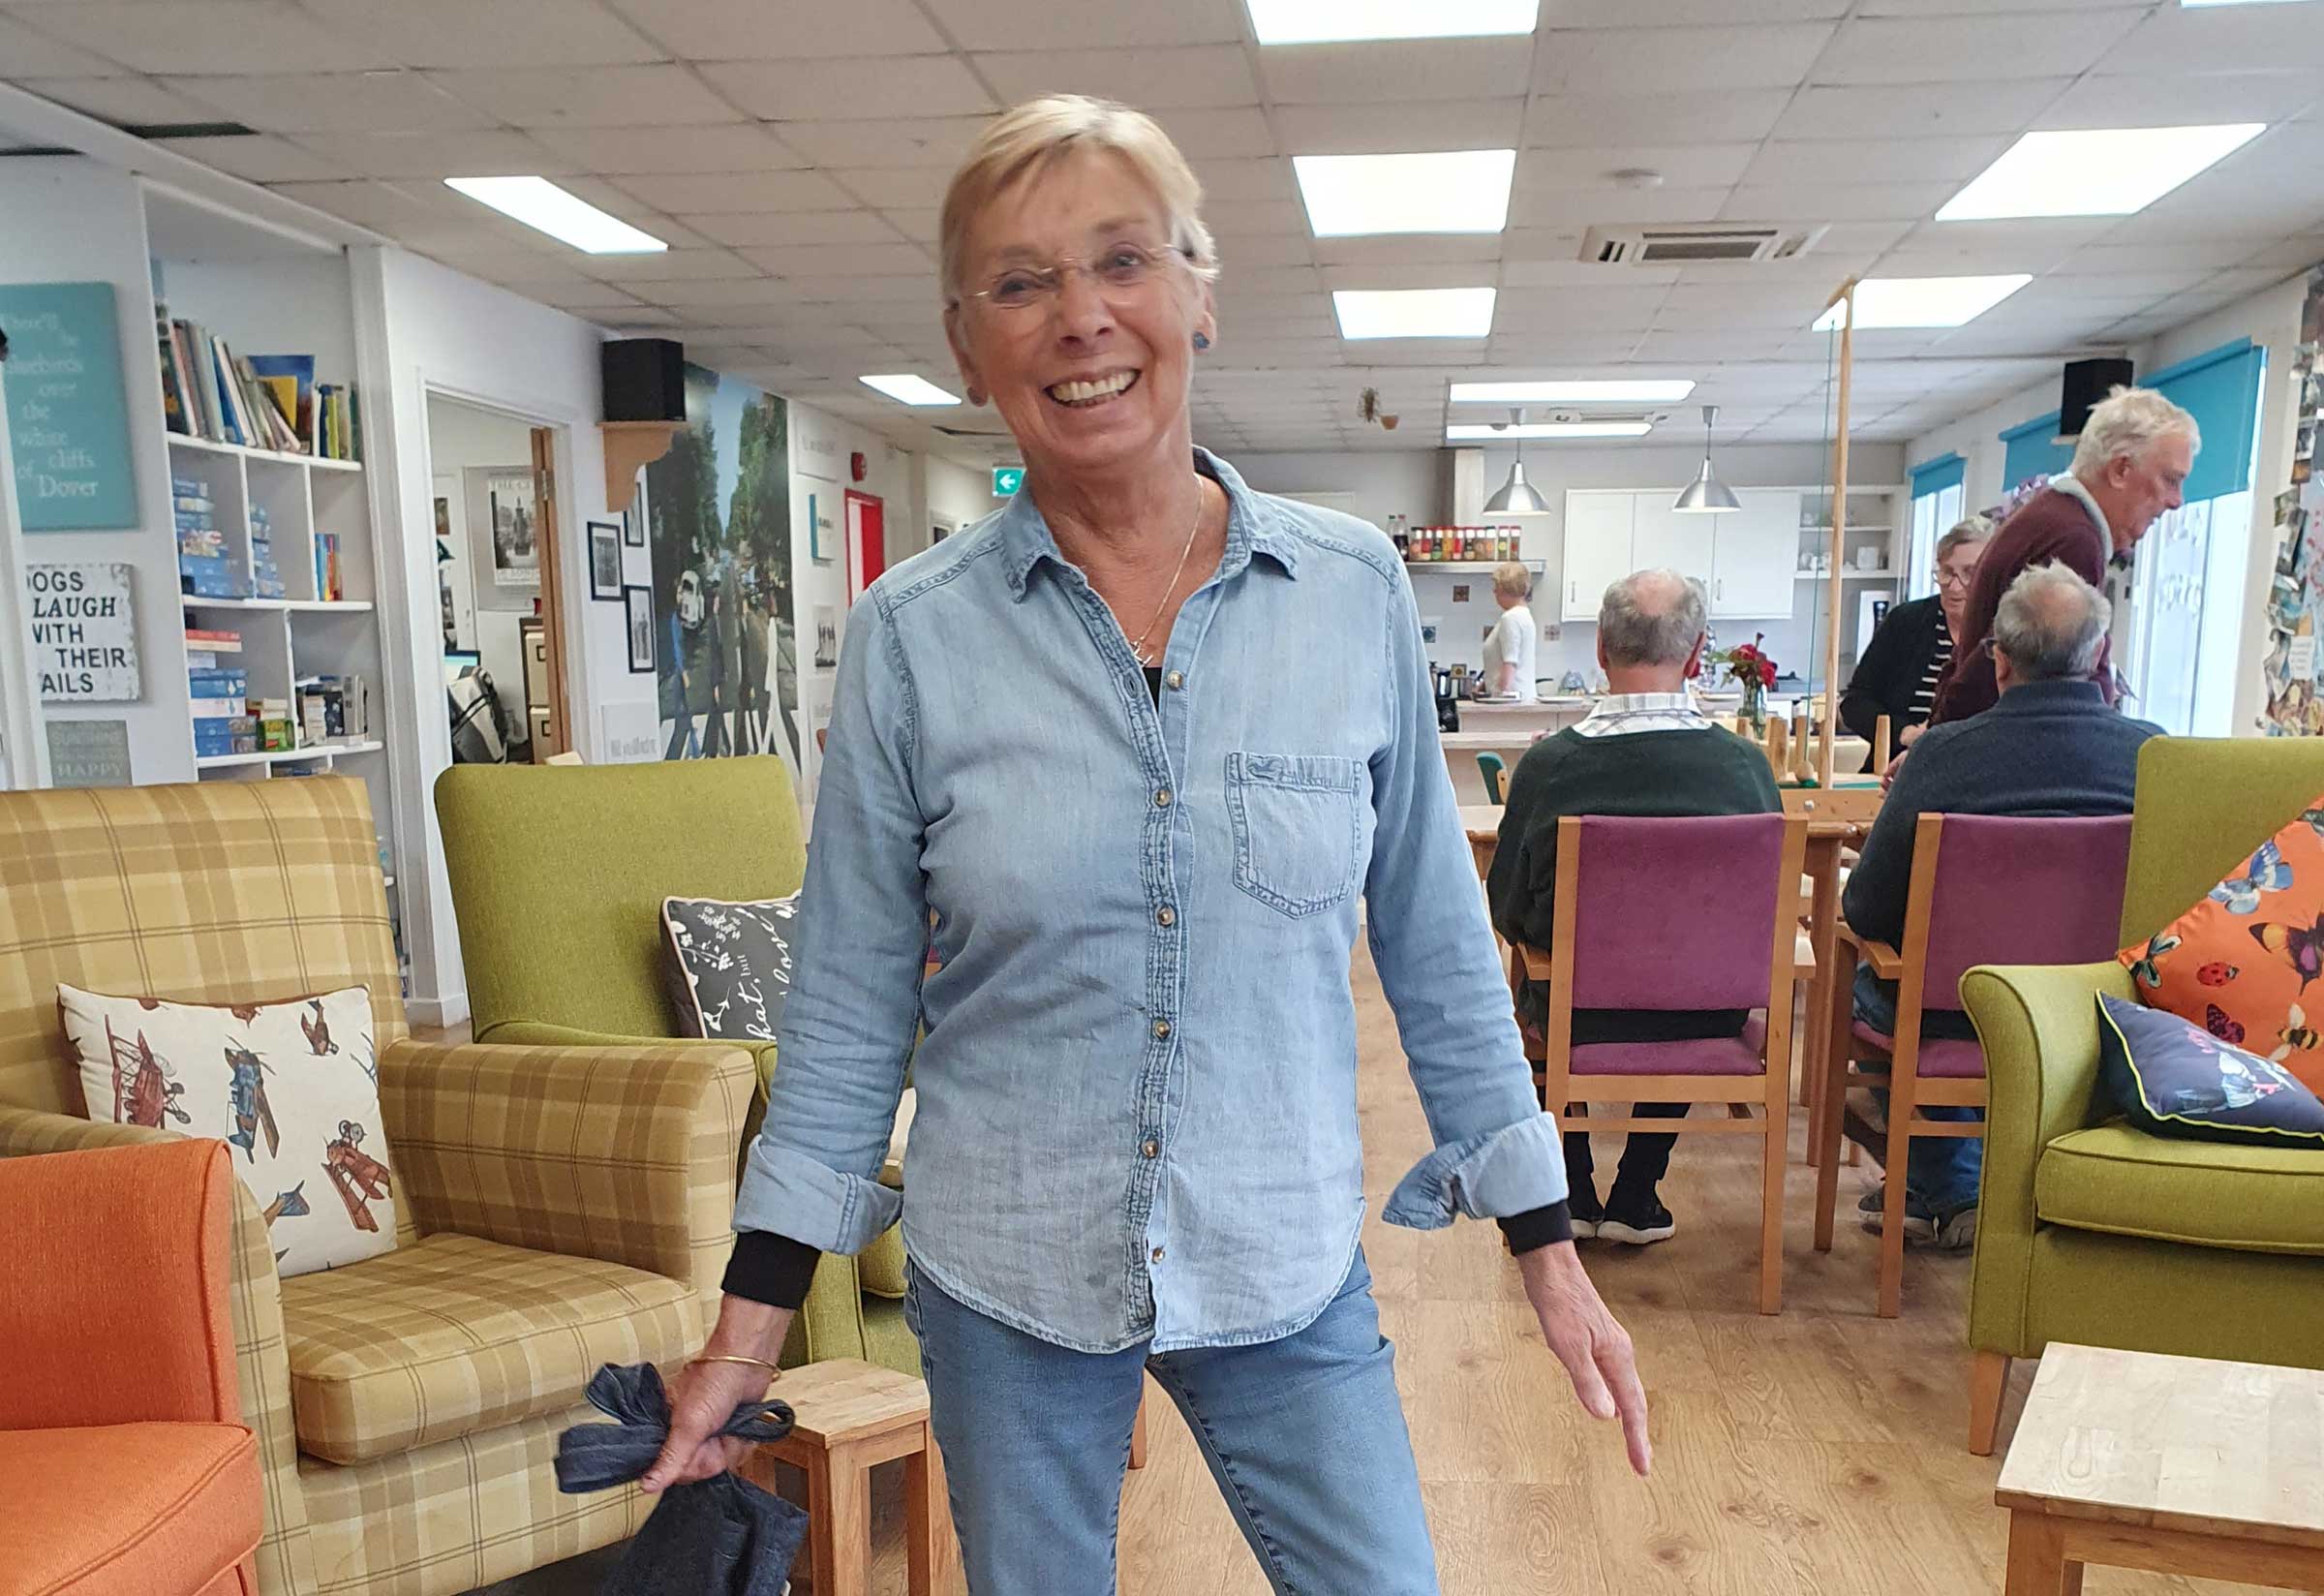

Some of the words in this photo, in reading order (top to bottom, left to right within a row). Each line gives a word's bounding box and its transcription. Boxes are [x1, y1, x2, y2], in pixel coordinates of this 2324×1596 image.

[39, 475, 98, 498] Dover
[27, 571, 83, 592] OGS
[33, 597, 116, 618] LAUGH
[55, 647, 127, 668] THEIR
[41, 672, 94, 693] AILS
